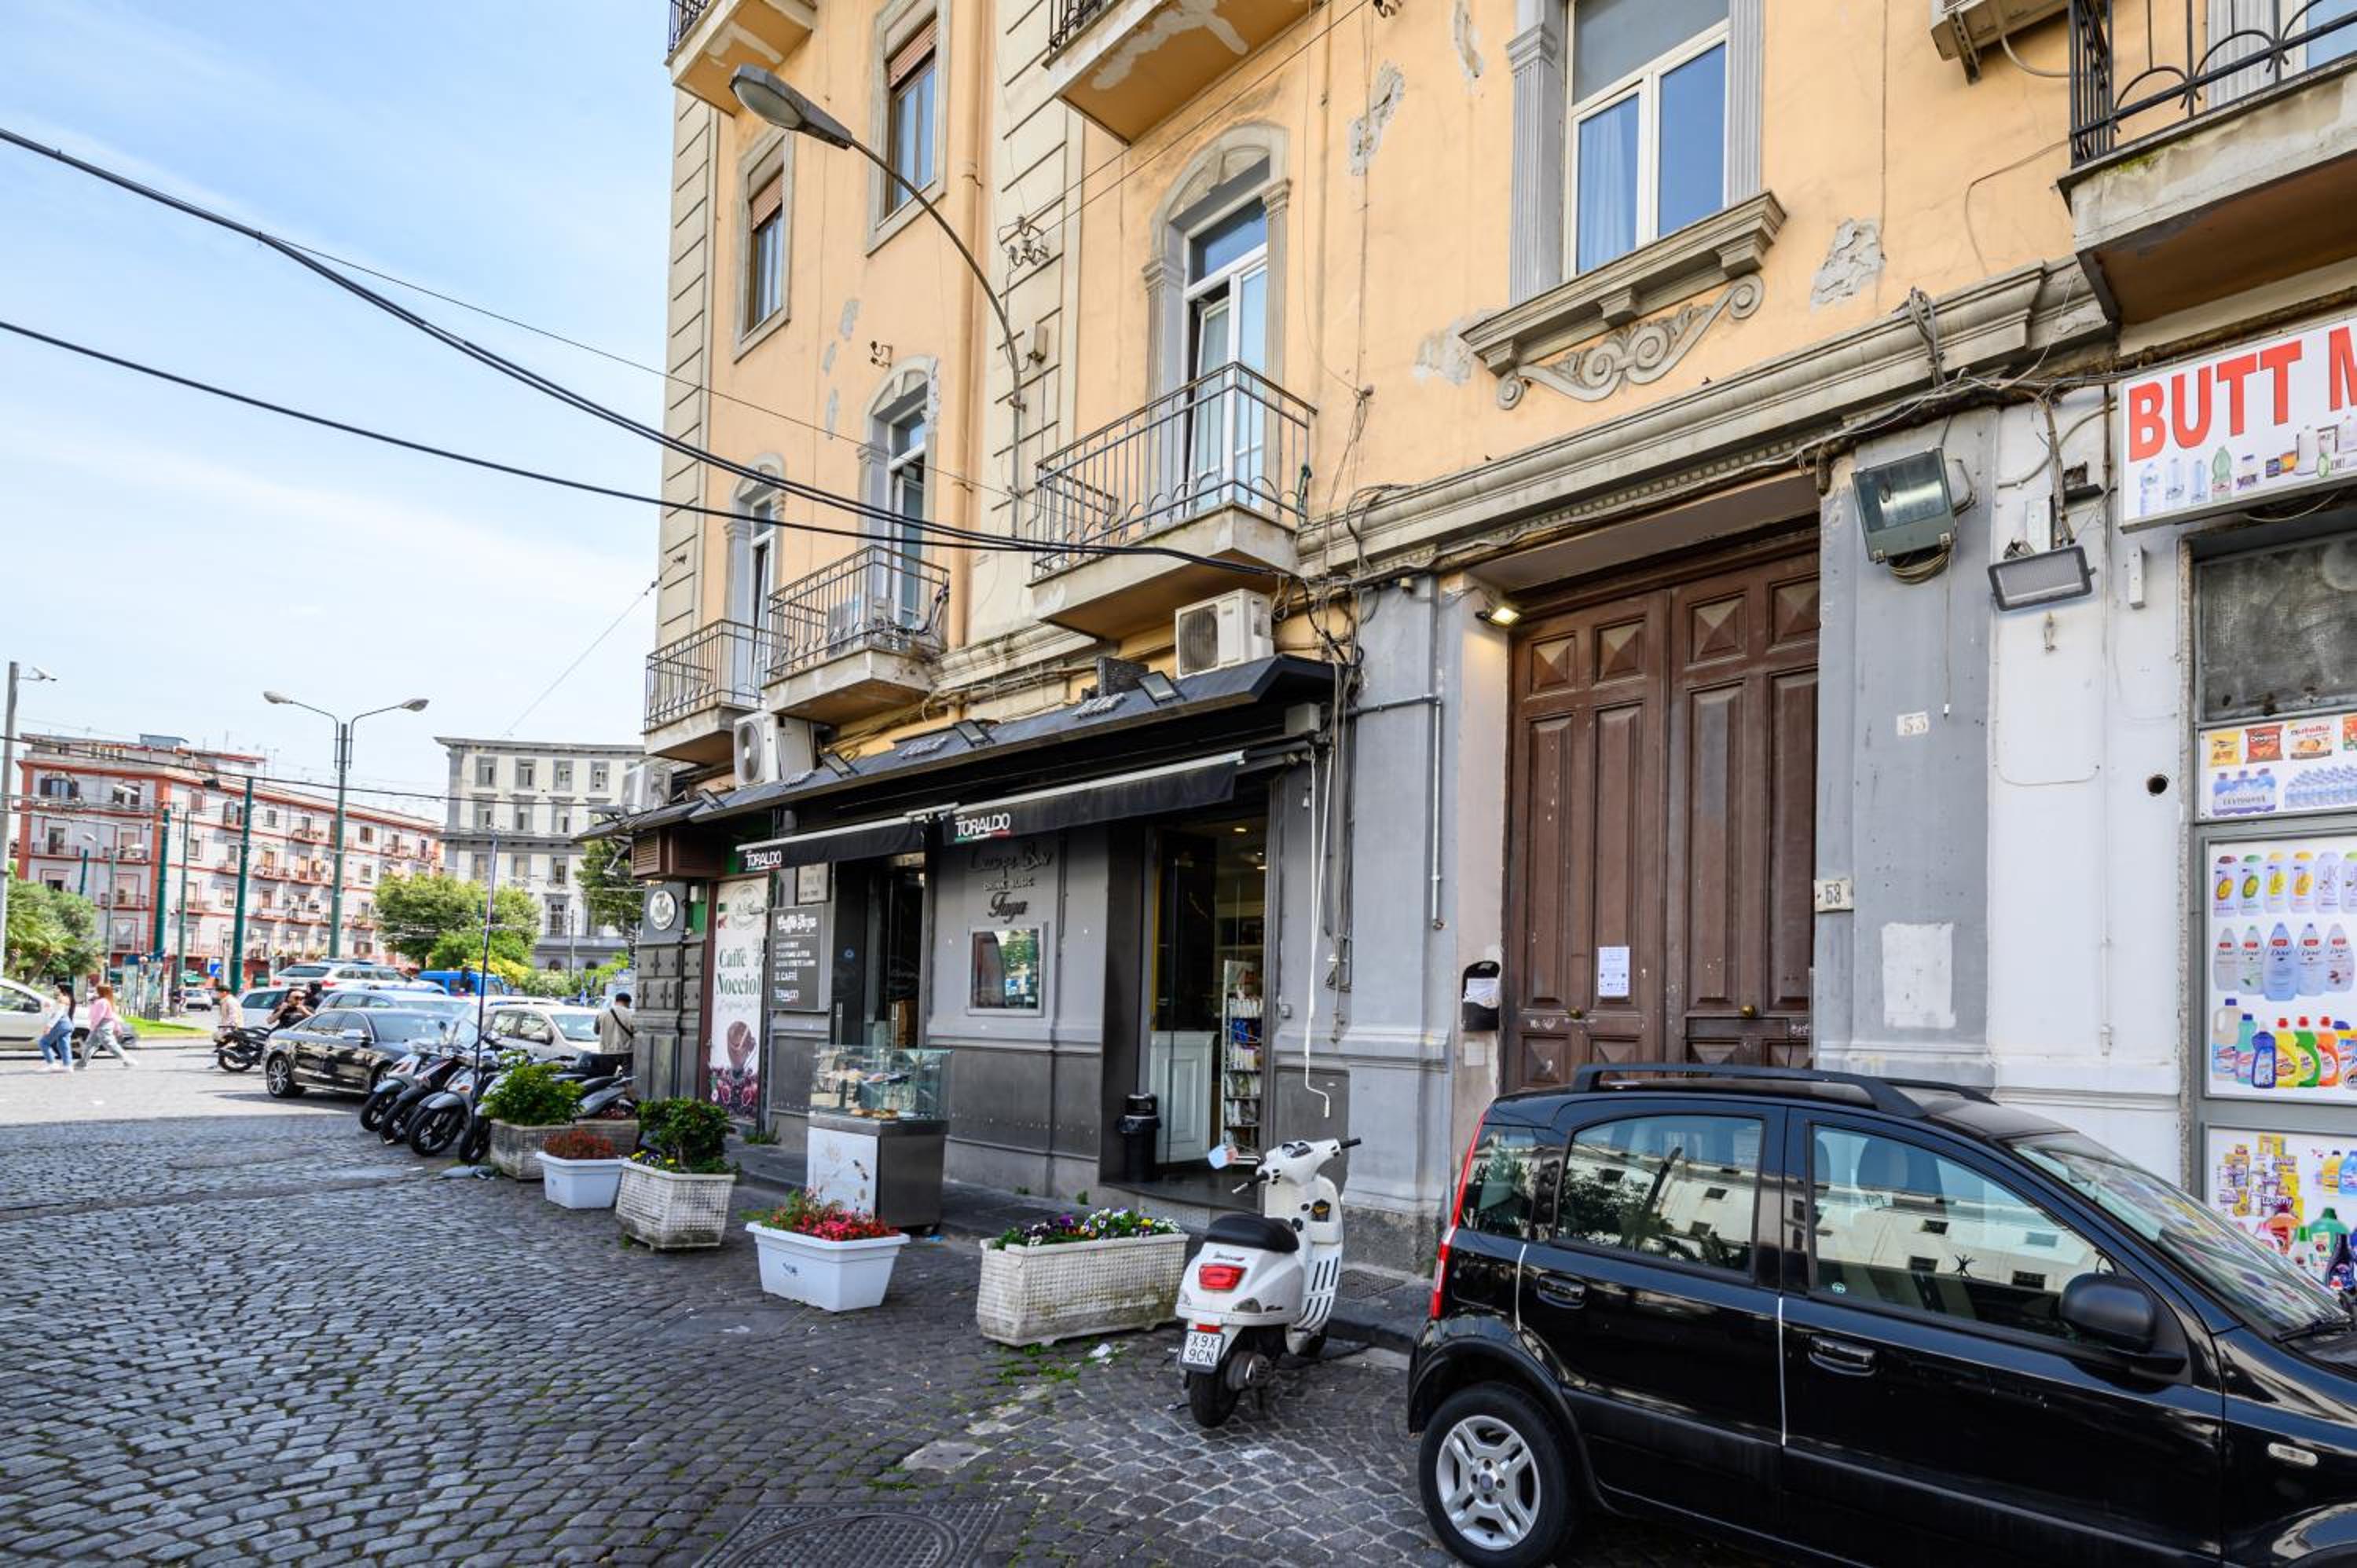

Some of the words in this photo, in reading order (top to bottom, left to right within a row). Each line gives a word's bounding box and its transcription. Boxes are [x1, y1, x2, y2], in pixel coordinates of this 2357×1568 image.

[2128, 339, 2302, 462] BUTT
[955, 812, 1011, 837] TORALDO
[745, 851, 782, 868] TORALDO
[1824, 883, 1842, 904] 53
[719, 947, 747, 969] Caffè
[1191, 1333, 1217, 1349] X9X
[1188, 1348, 1215, 1364] 9CN
